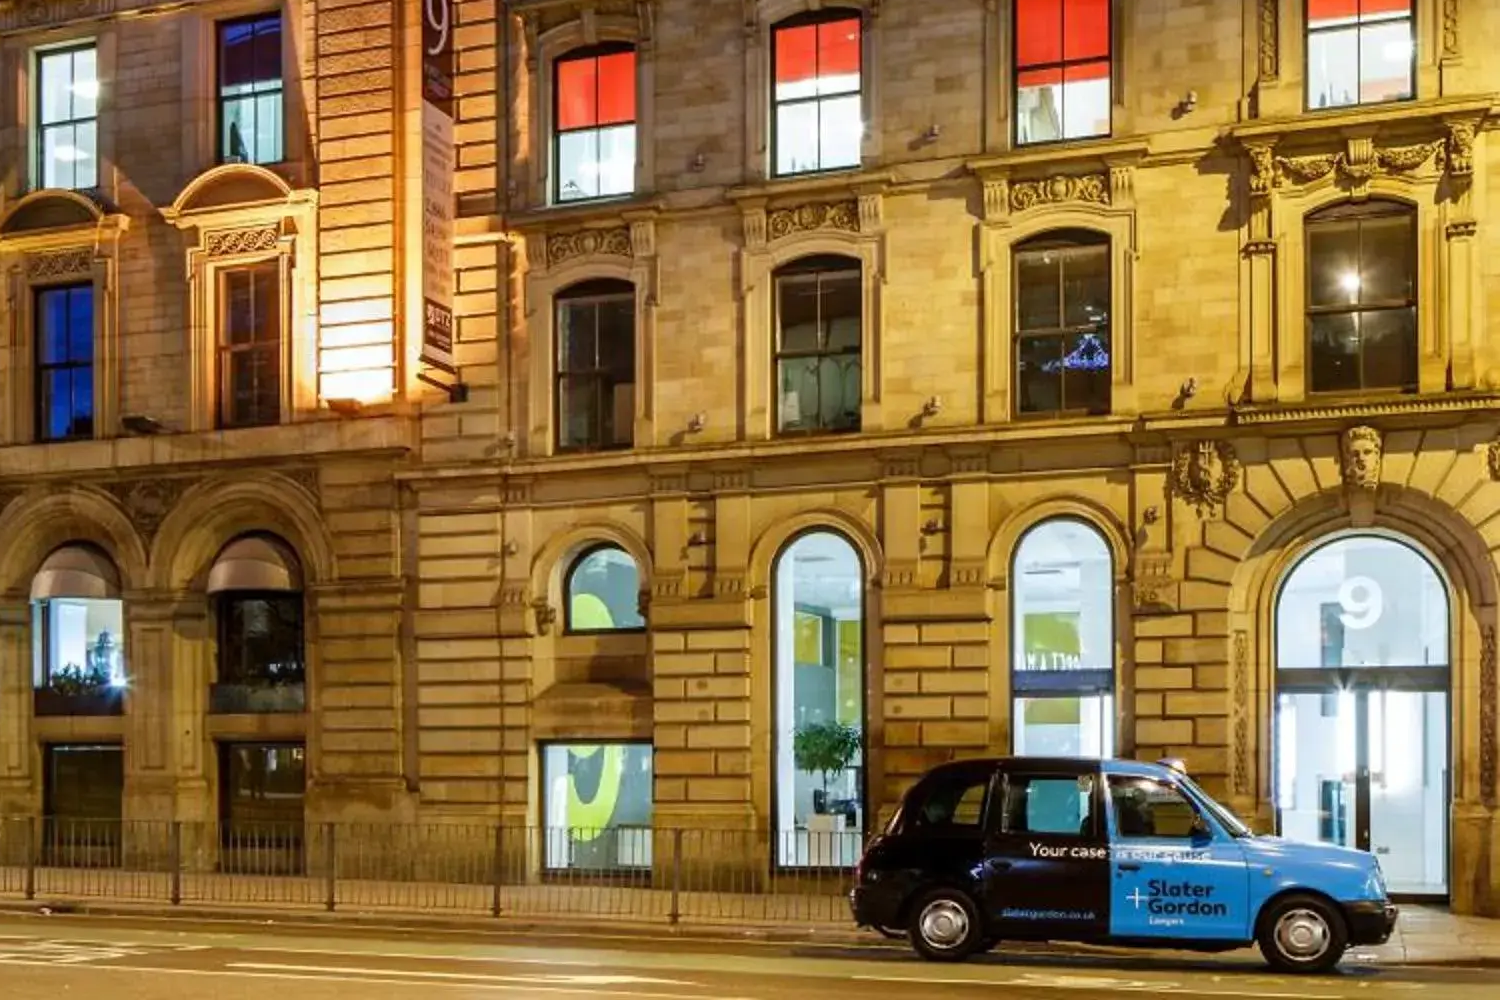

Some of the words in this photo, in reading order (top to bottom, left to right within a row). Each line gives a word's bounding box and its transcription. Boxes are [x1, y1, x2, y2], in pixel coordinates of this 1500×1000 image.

[1338, 575, 1383, 630] 9
[1029, 841, 1069, 858] Your
[1070, 846, 1107, 860] case
[1147, 879, 1215, 898] Slater
[1147, 898, 1227, 916] Gordon
